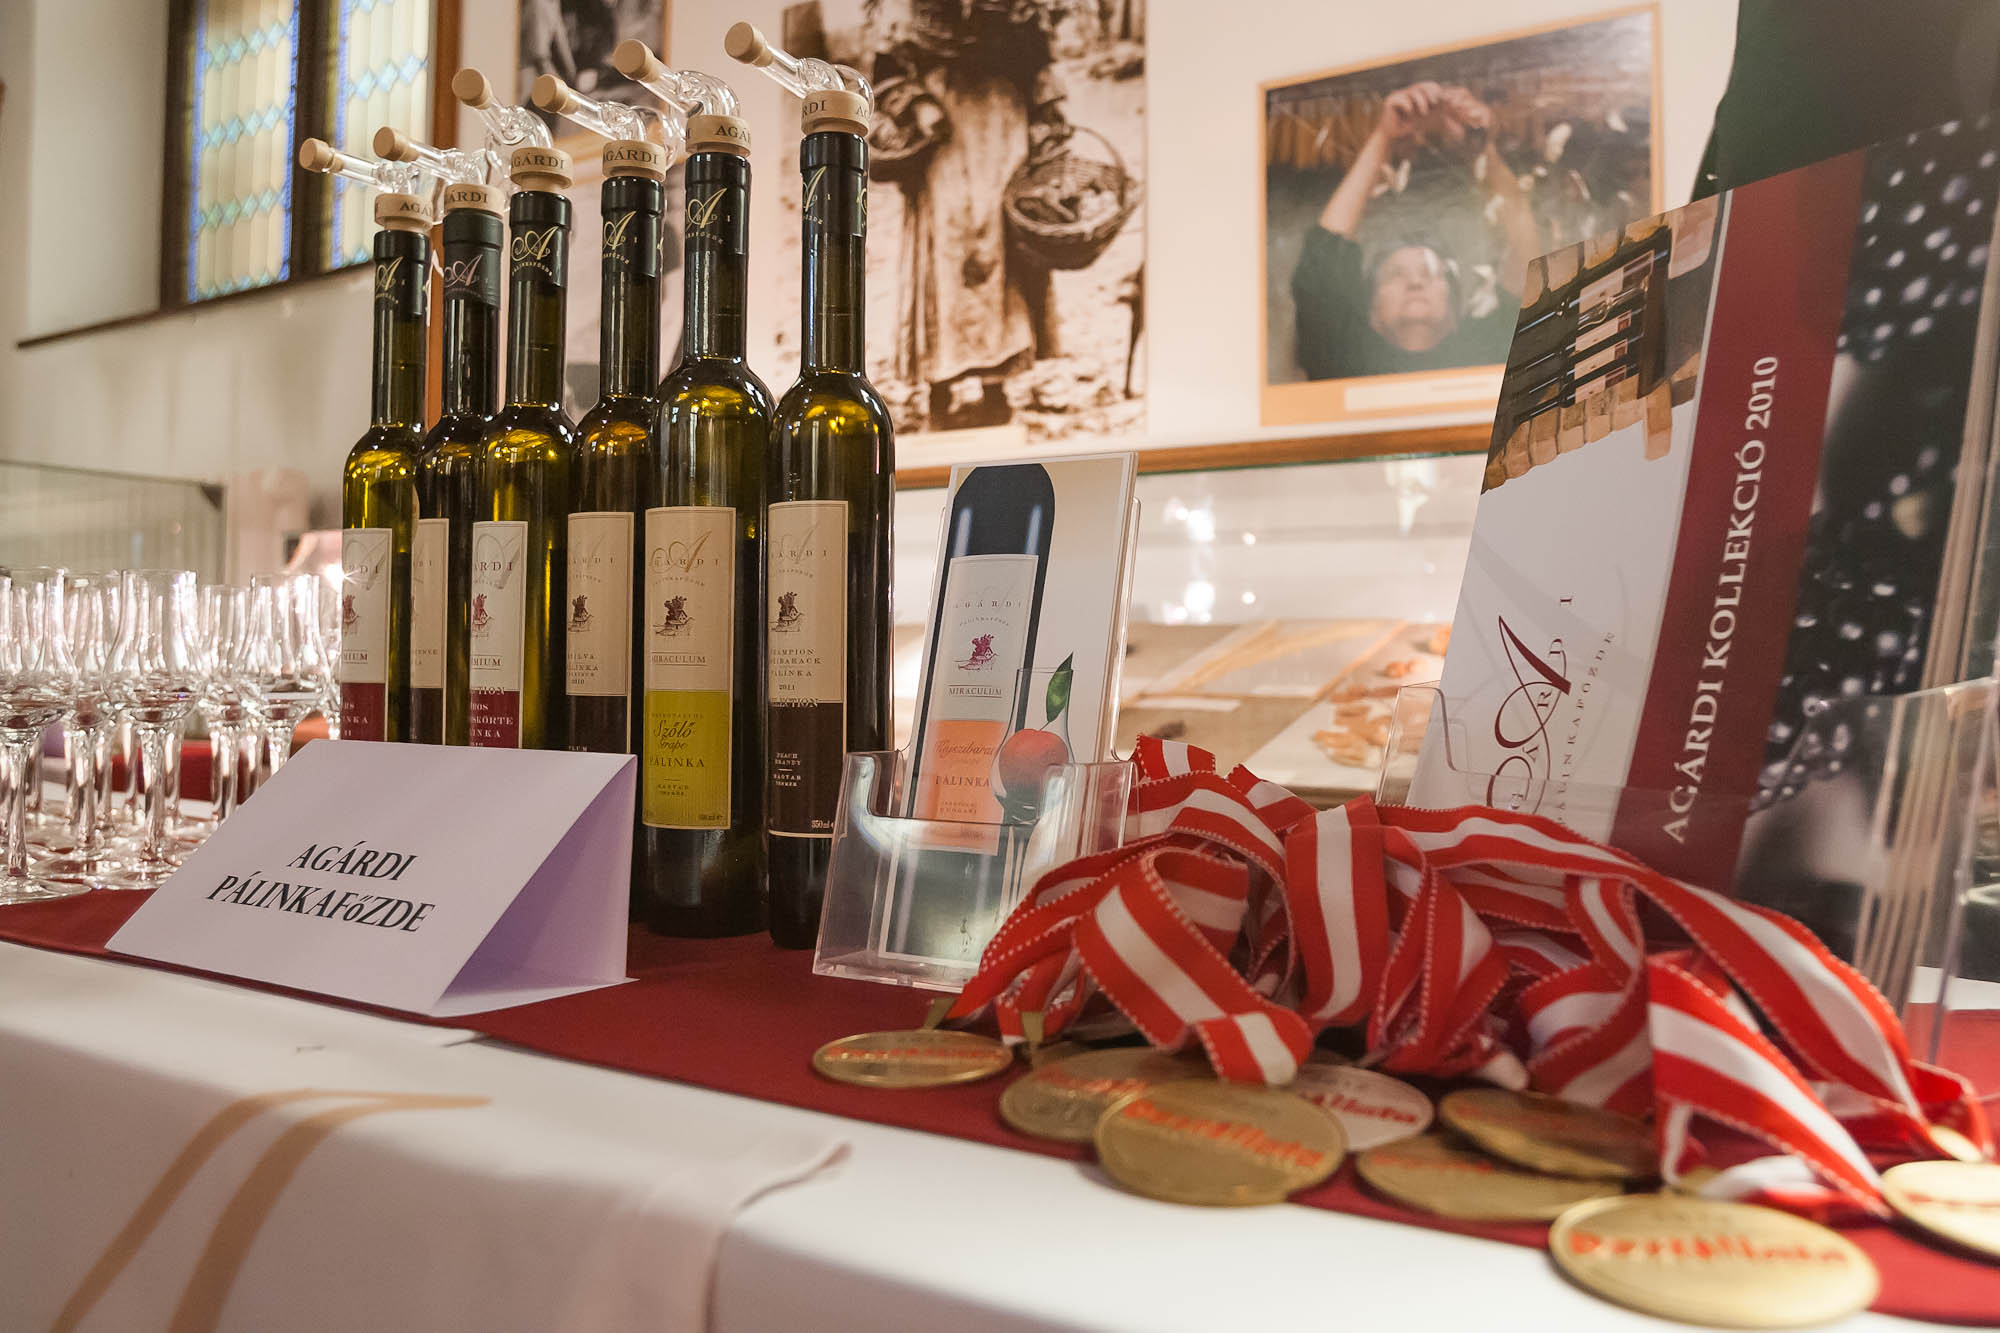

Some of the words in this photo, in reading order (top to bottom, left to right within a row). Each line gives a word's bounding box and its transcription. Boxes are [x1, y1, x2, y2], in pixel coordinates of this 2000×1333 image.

[1662, 678, 1724, 845] AGÁRDI
[1703, 441, 1768, 671] KOLLEKCIÓ
[1743, 356, 1779, 431] 2010
[287, 841, 419, 881] AGÁRDI
